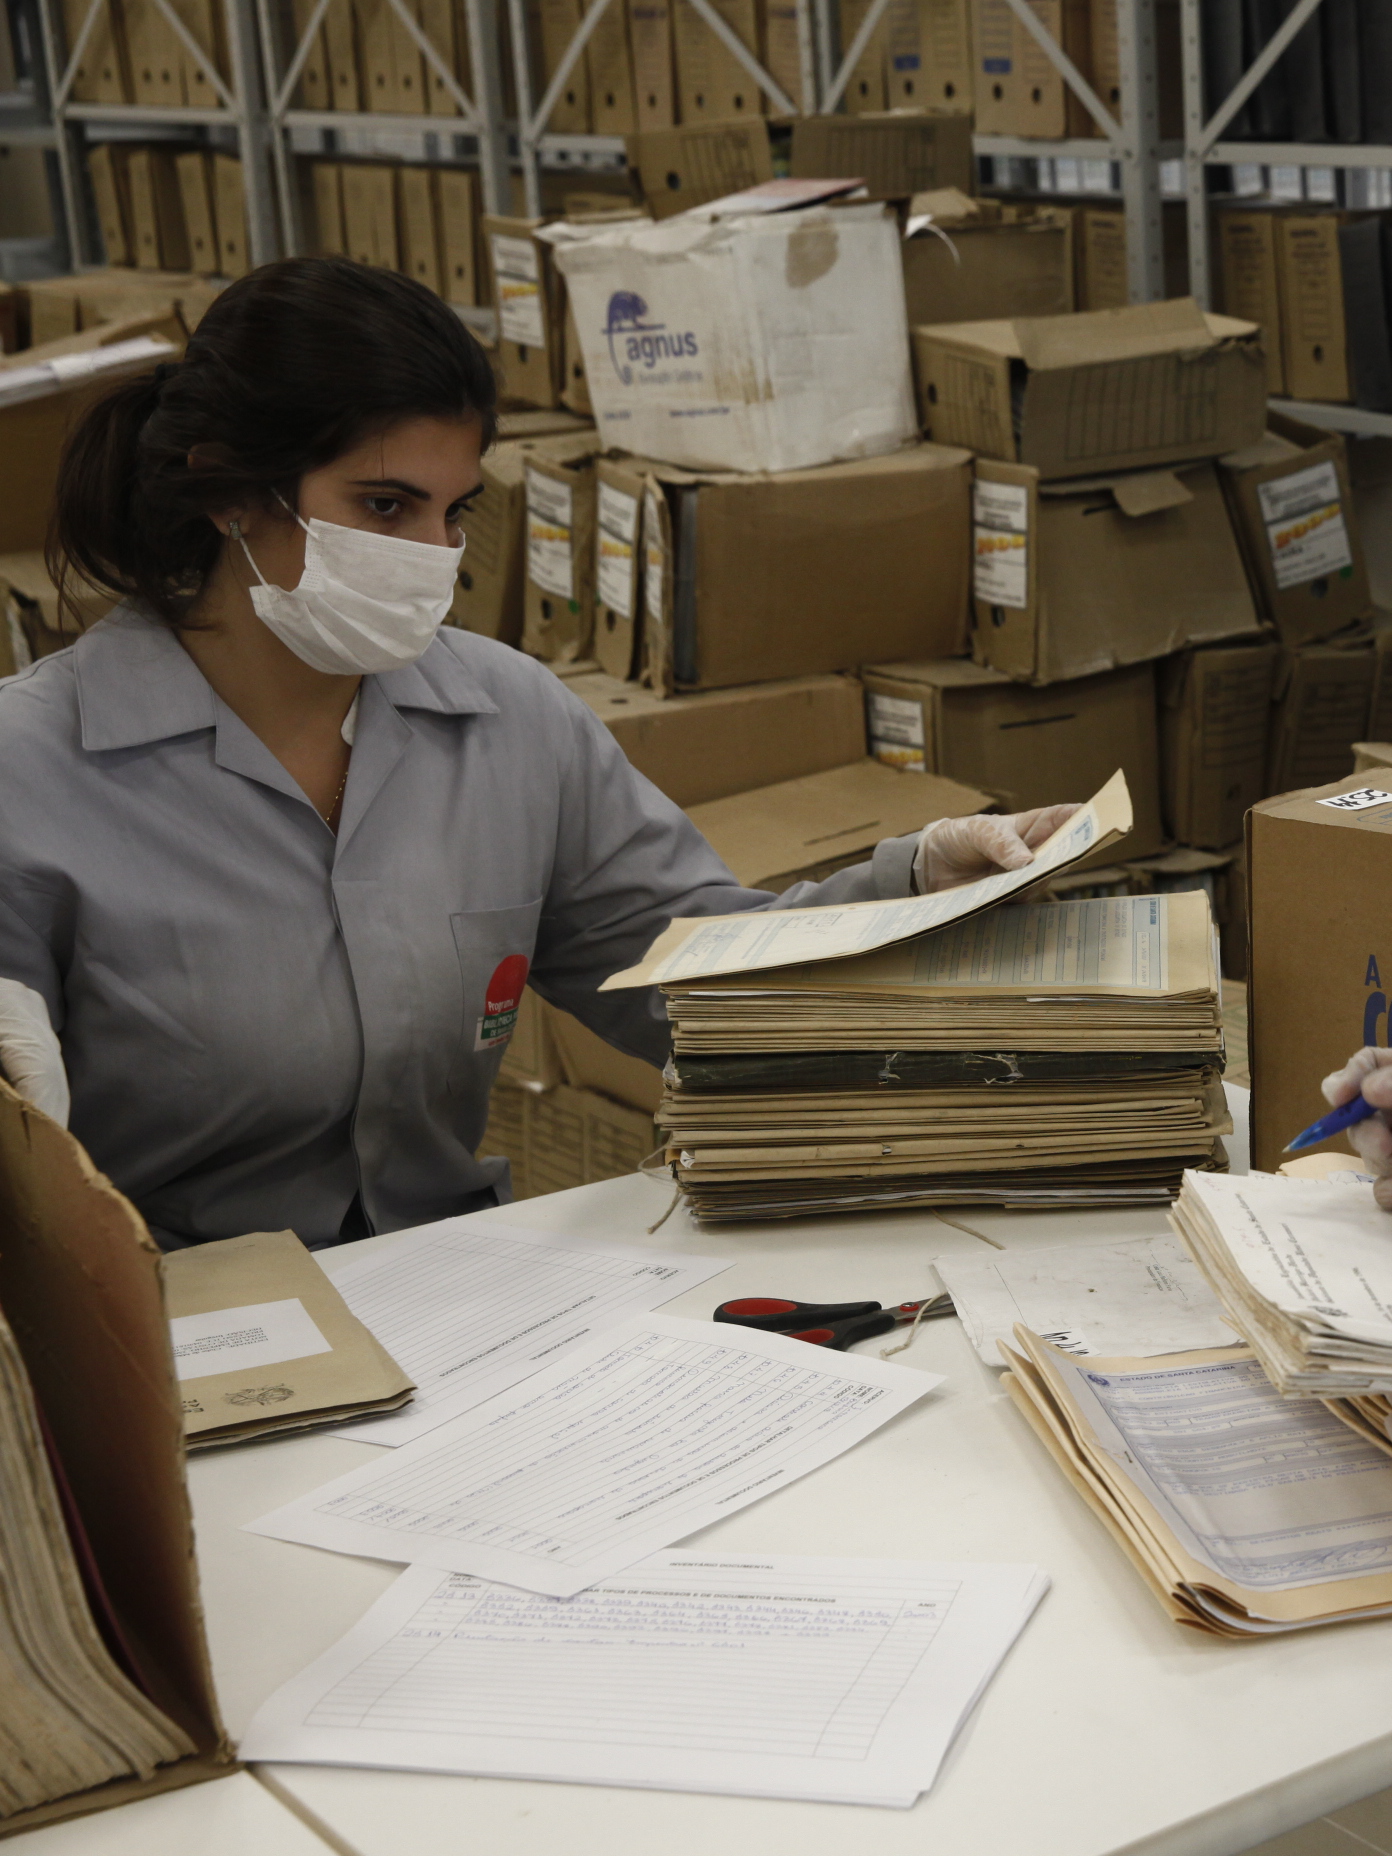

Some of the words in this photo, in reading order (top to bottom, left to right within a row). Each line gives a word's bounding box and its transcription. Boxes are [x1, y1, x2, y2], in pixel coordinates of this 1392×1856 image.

[626, 332, 698, 369] agnus
[487, 998, 514, 1013] Programa
[1165, 1370, 1194, 1378] SANTA
[1196, 1365, 1236, 1375] CATARINA
